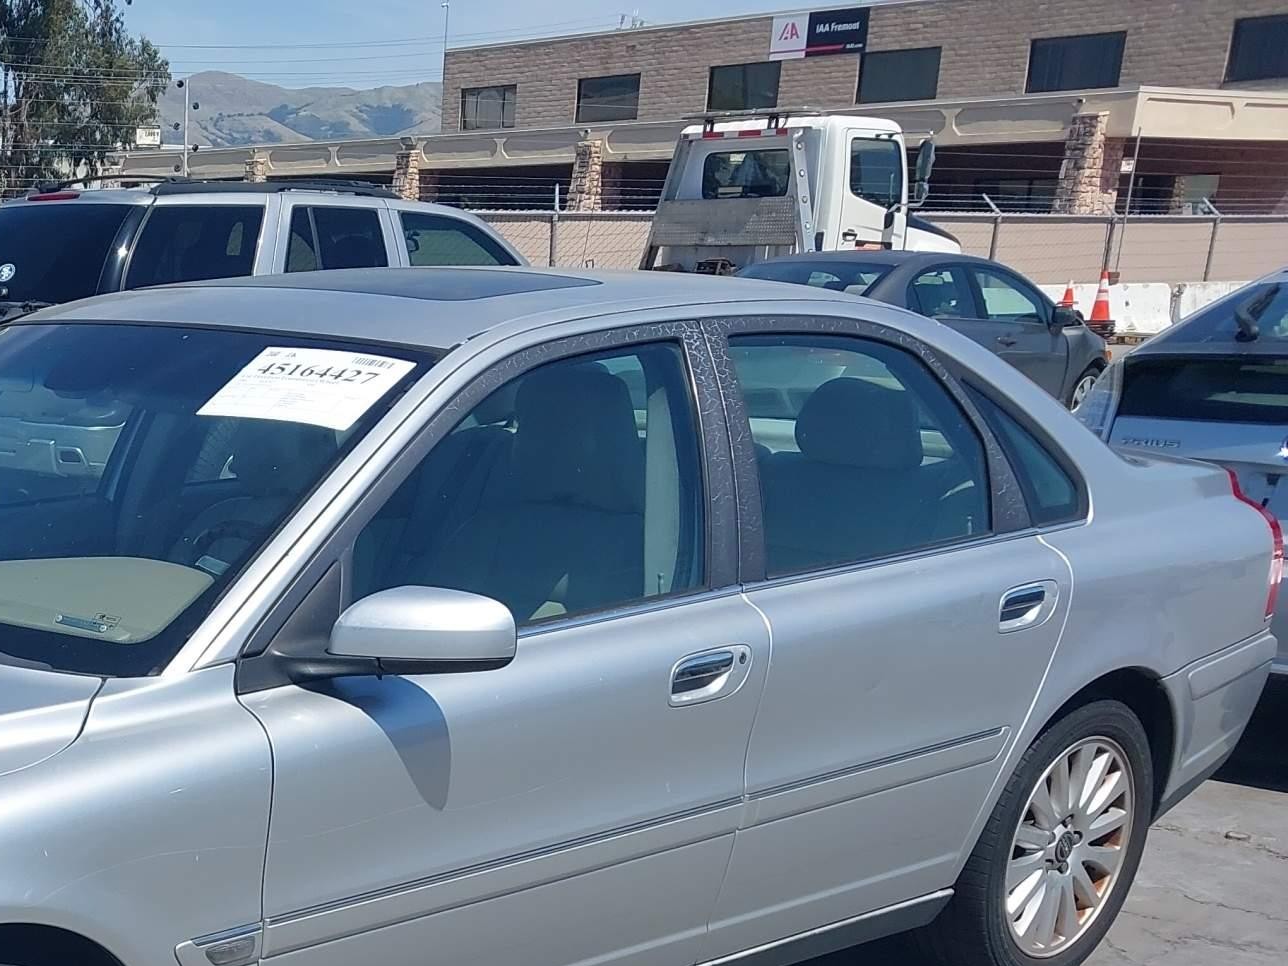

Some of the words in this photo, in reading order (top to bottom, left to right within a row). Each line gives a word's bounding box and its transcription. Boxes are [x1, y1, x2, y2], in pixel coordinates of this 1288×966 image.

[816, 23, 830, 34] IAA
[830, 21, 861, 32] Fremont
[257, 362, 381, 385] 45164427
